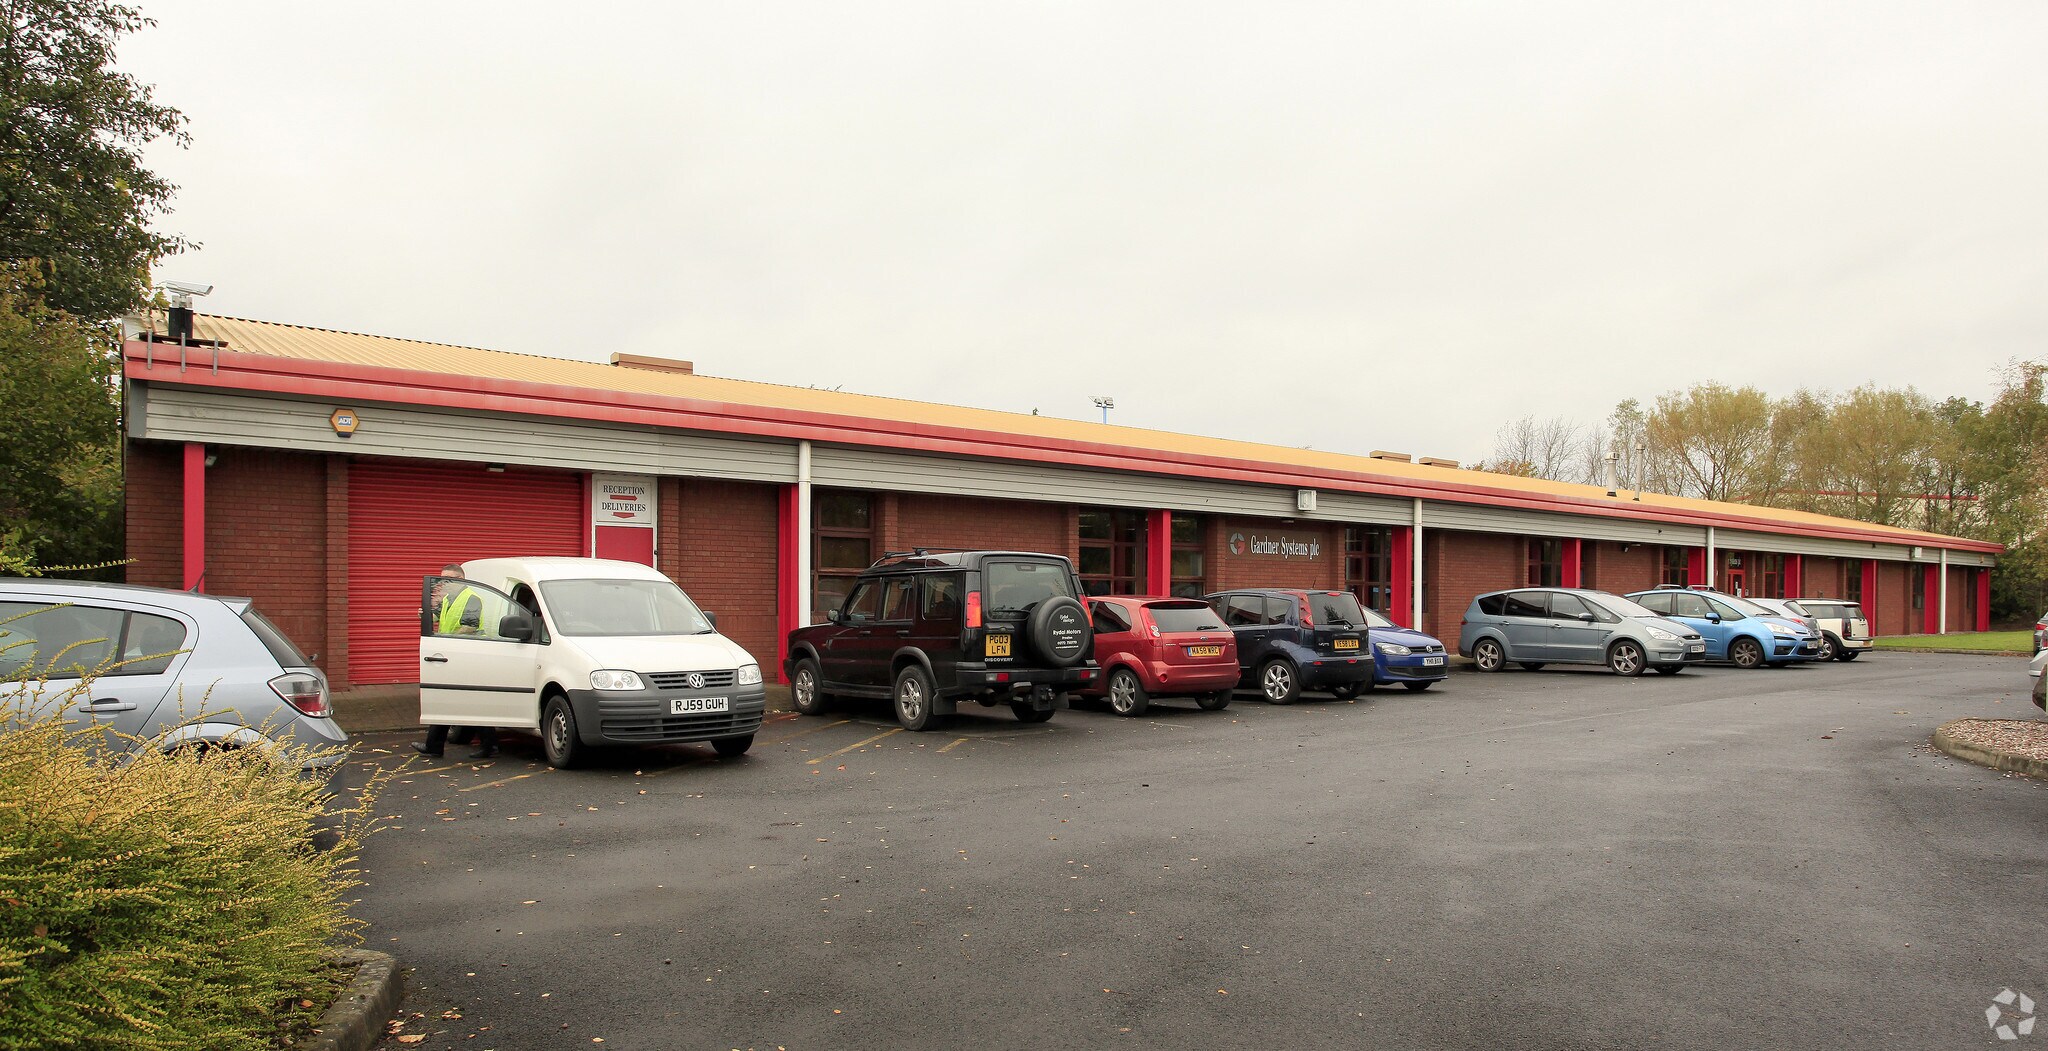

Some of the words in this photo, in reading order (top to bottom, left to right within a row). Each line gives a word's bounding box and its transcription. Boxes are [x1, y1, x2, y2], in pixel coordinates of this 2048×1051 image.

[338, 417, 351, 425] ADT
[603, 485, 645, 495] RECEPTION
[602, 502, 647, 512] DELIVERIES
[1250, 535, 1279, 555] Gardner
[1281, 536, 1308, 559] Systems
[1309, 538, 1320, 560] plc
[989, 635, 1009, 644] PG03
[991, 645, 1007, 654] LFN
[675, 698, 703, 712] RJ59
[705, 698, 725, 710] GUH
